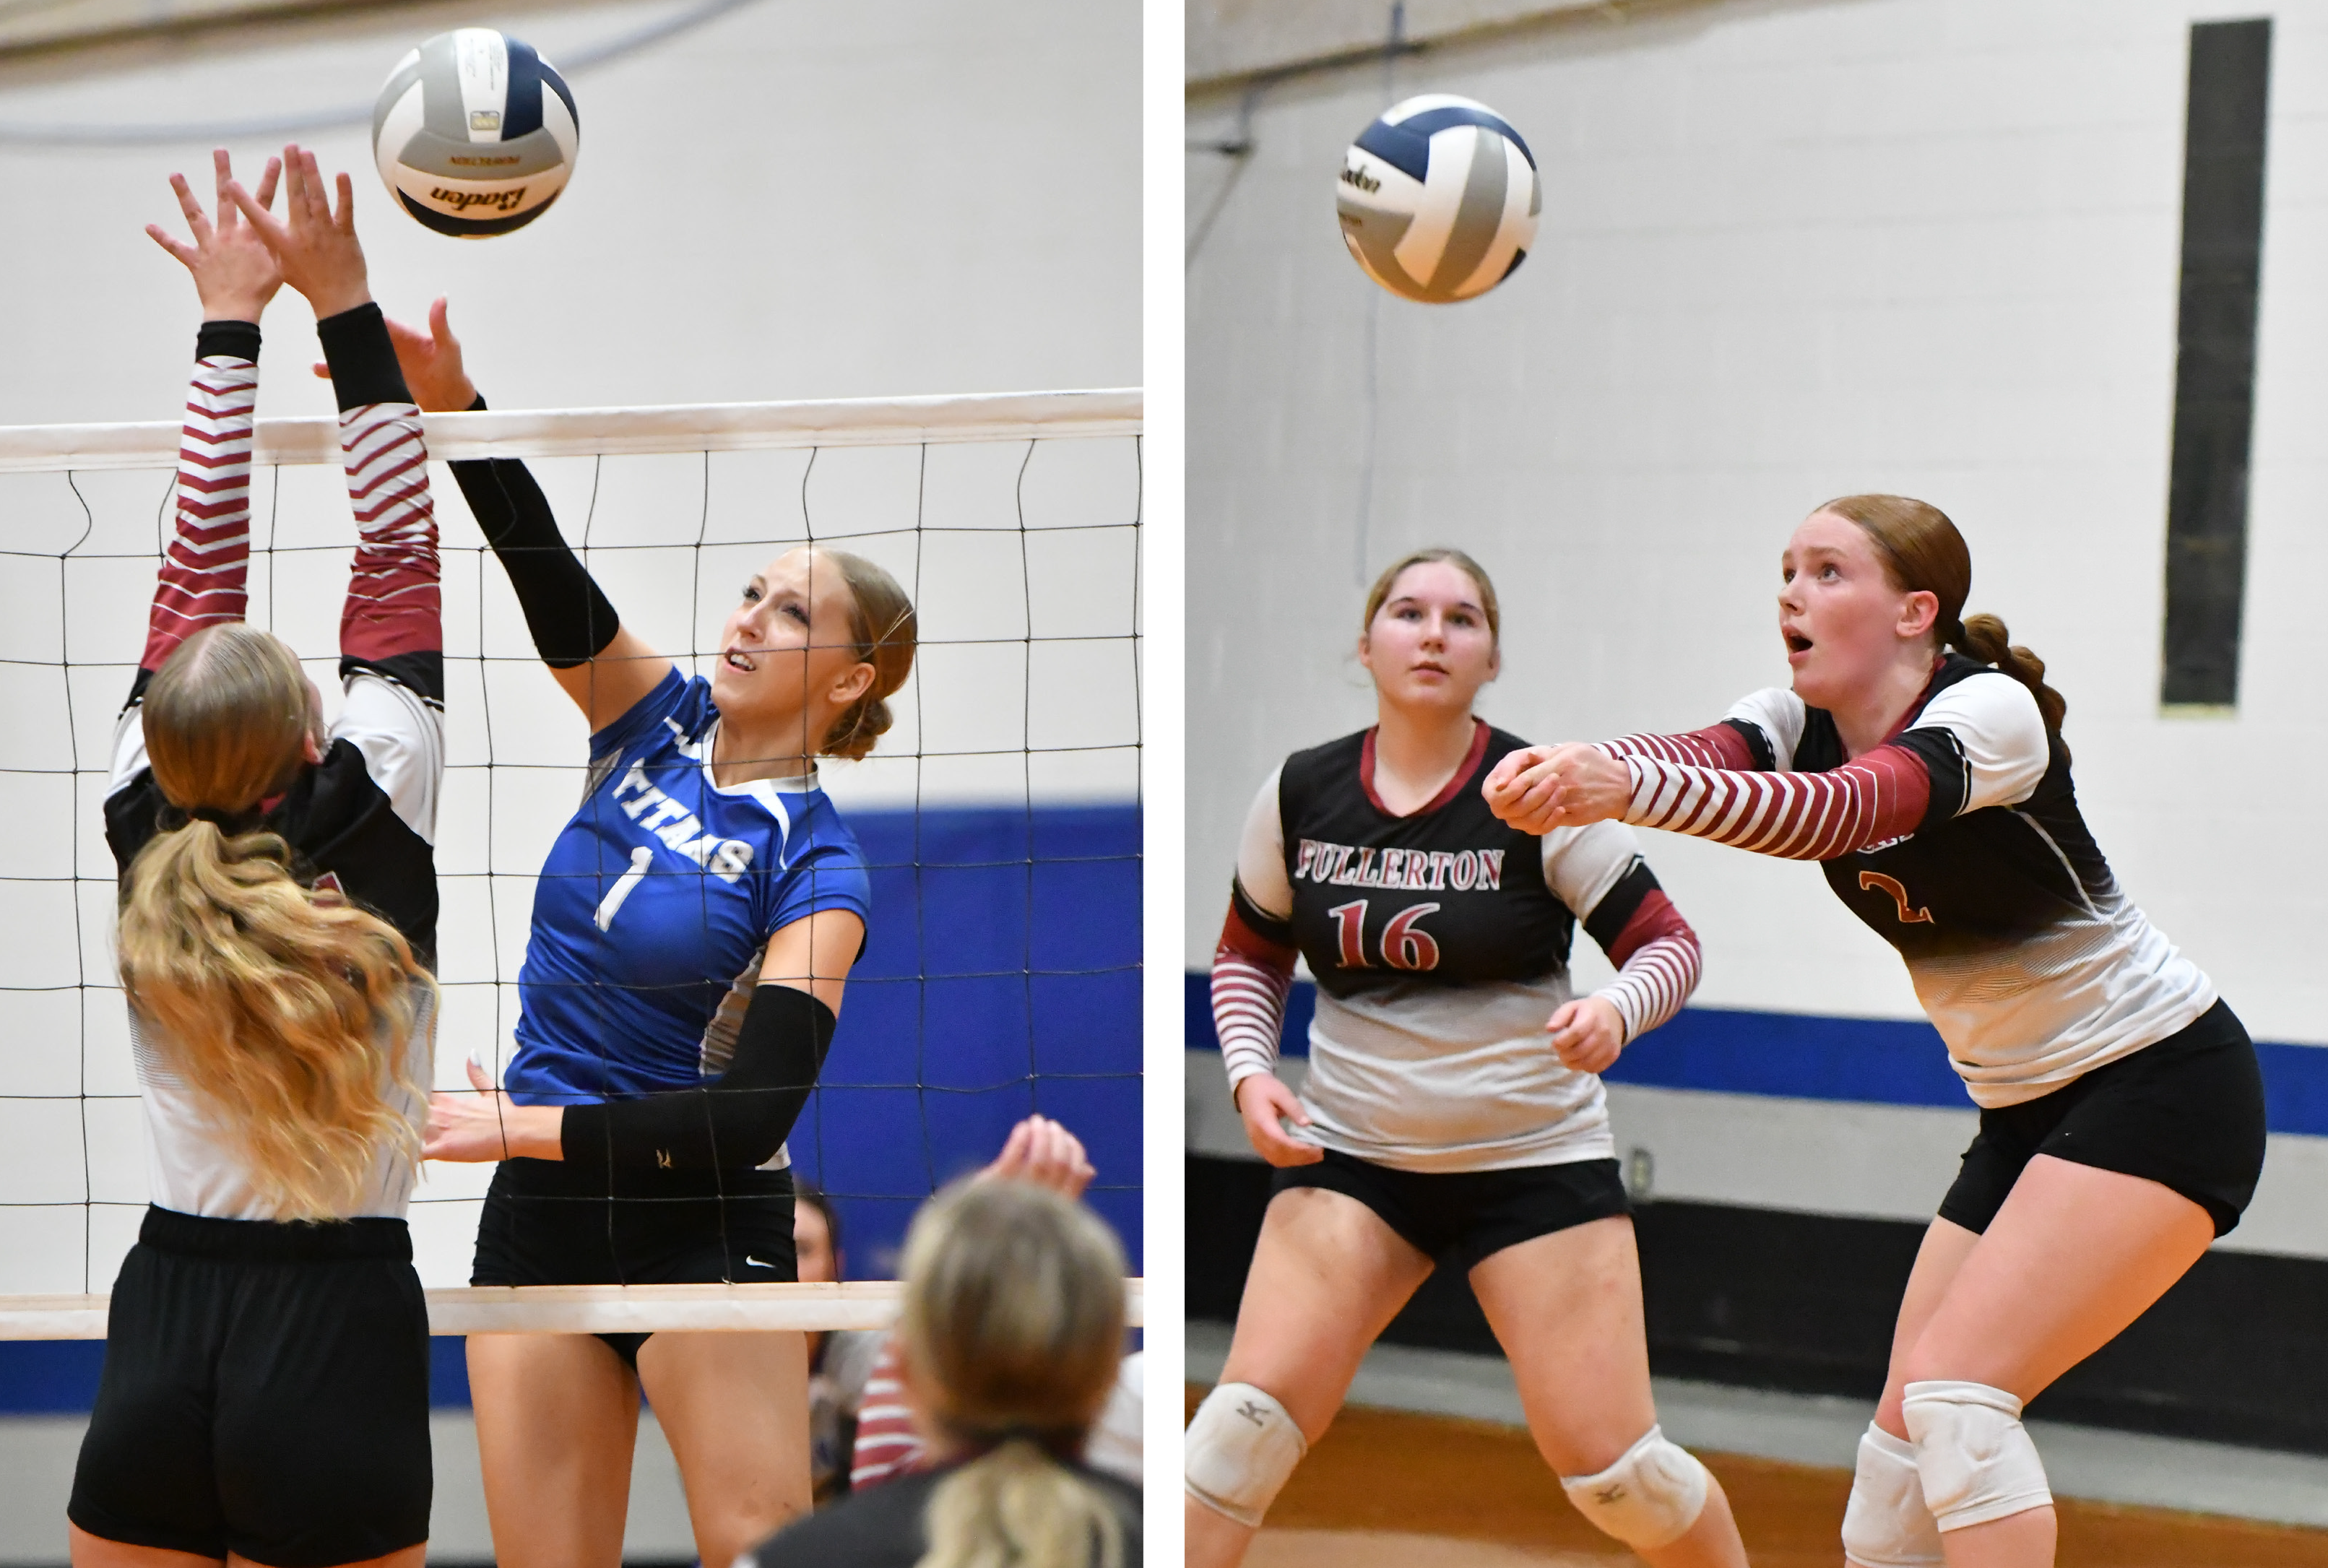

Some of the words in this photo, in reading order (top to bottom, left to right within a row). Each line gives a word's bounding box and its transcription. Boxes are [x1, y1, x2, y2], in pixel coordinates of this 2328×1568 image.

[430, 186, 527, 212] Baden
[612, 757, 754, 884] TITANS
[593, 846, 654, 933] 1
[1294, 838, 1505, 891] FULLERTON
[1858, 870, 1936, 924] 2
[1328, 898, 1441, 971] 16
